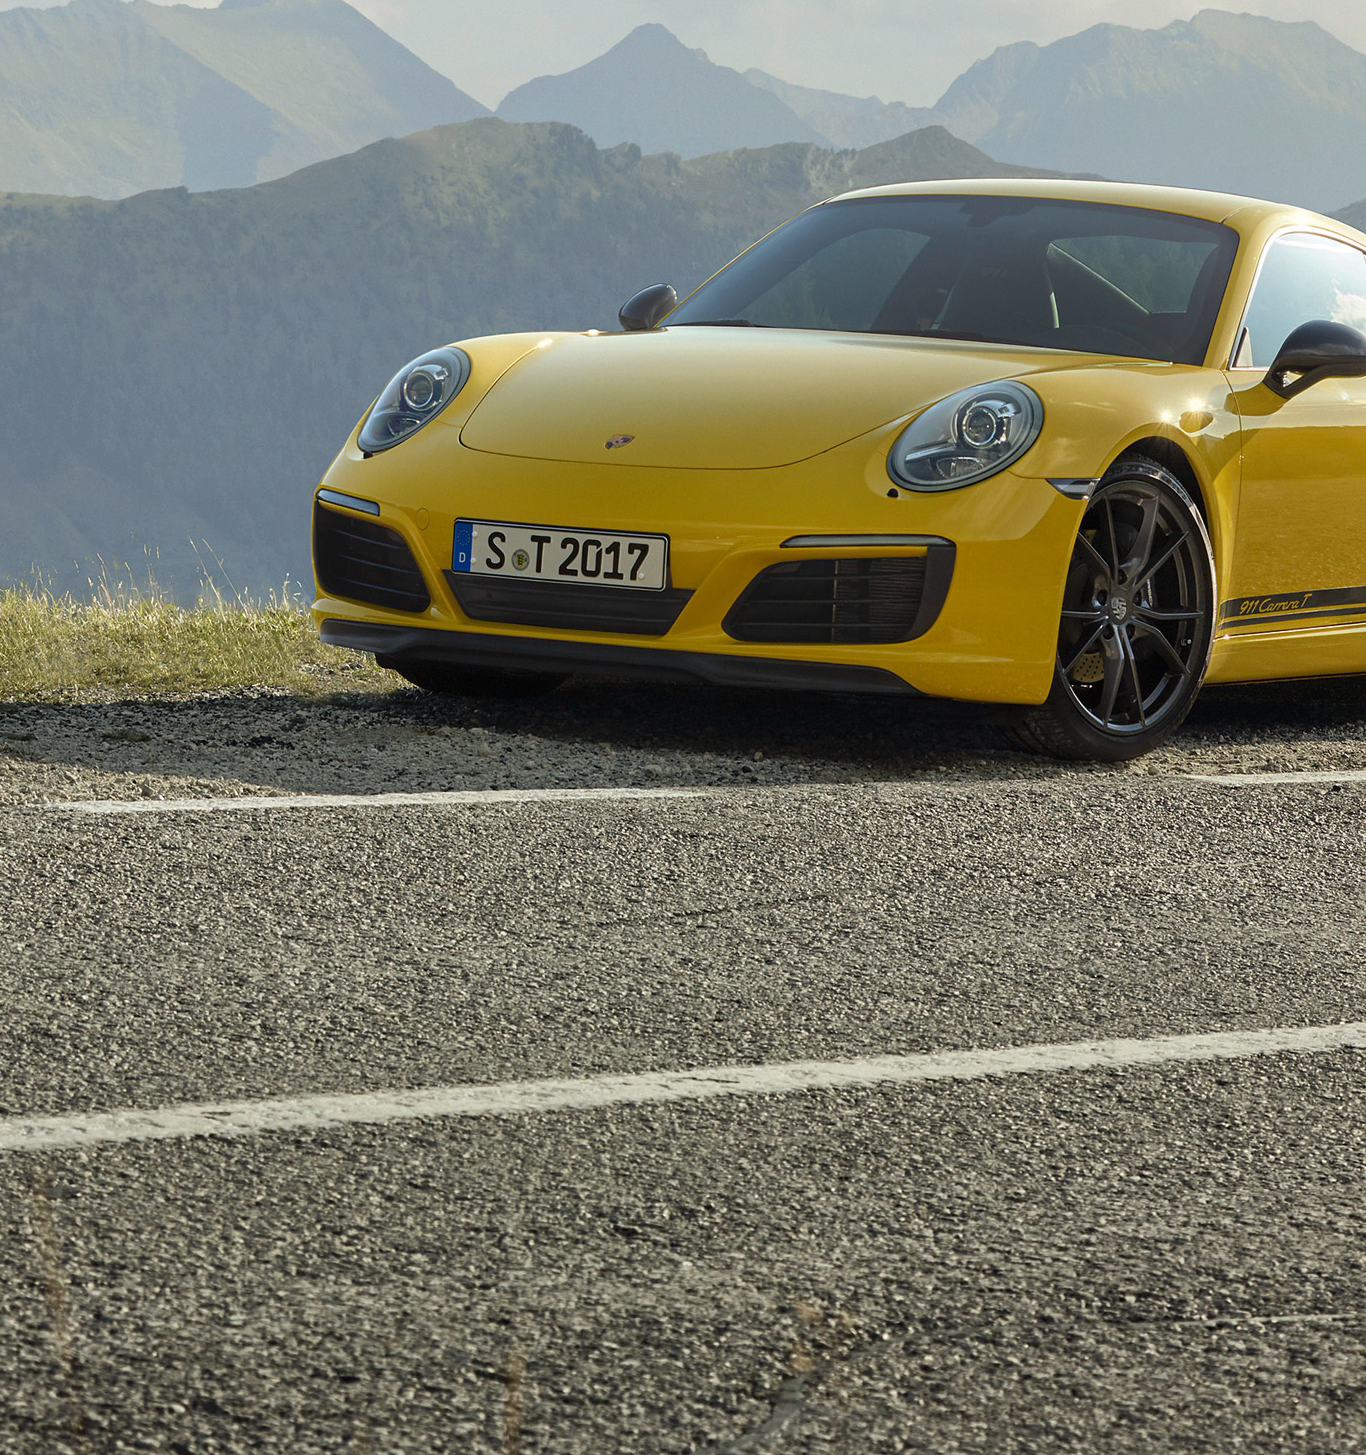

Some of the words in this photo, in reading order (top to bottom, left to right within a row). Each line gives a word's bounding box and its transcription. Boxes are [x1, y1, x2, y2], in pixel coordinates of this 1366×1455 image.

[458, 551, 466, 563] D
[485, 531, 506, 570] S
[530, 534, 552, 573] T
[558, 537, 650, 581] 2017
[1239, 600, 1260, 615] 911
[1259, 597, 1300, 613] Carrera
[1301, 593, 1313, 607] T
